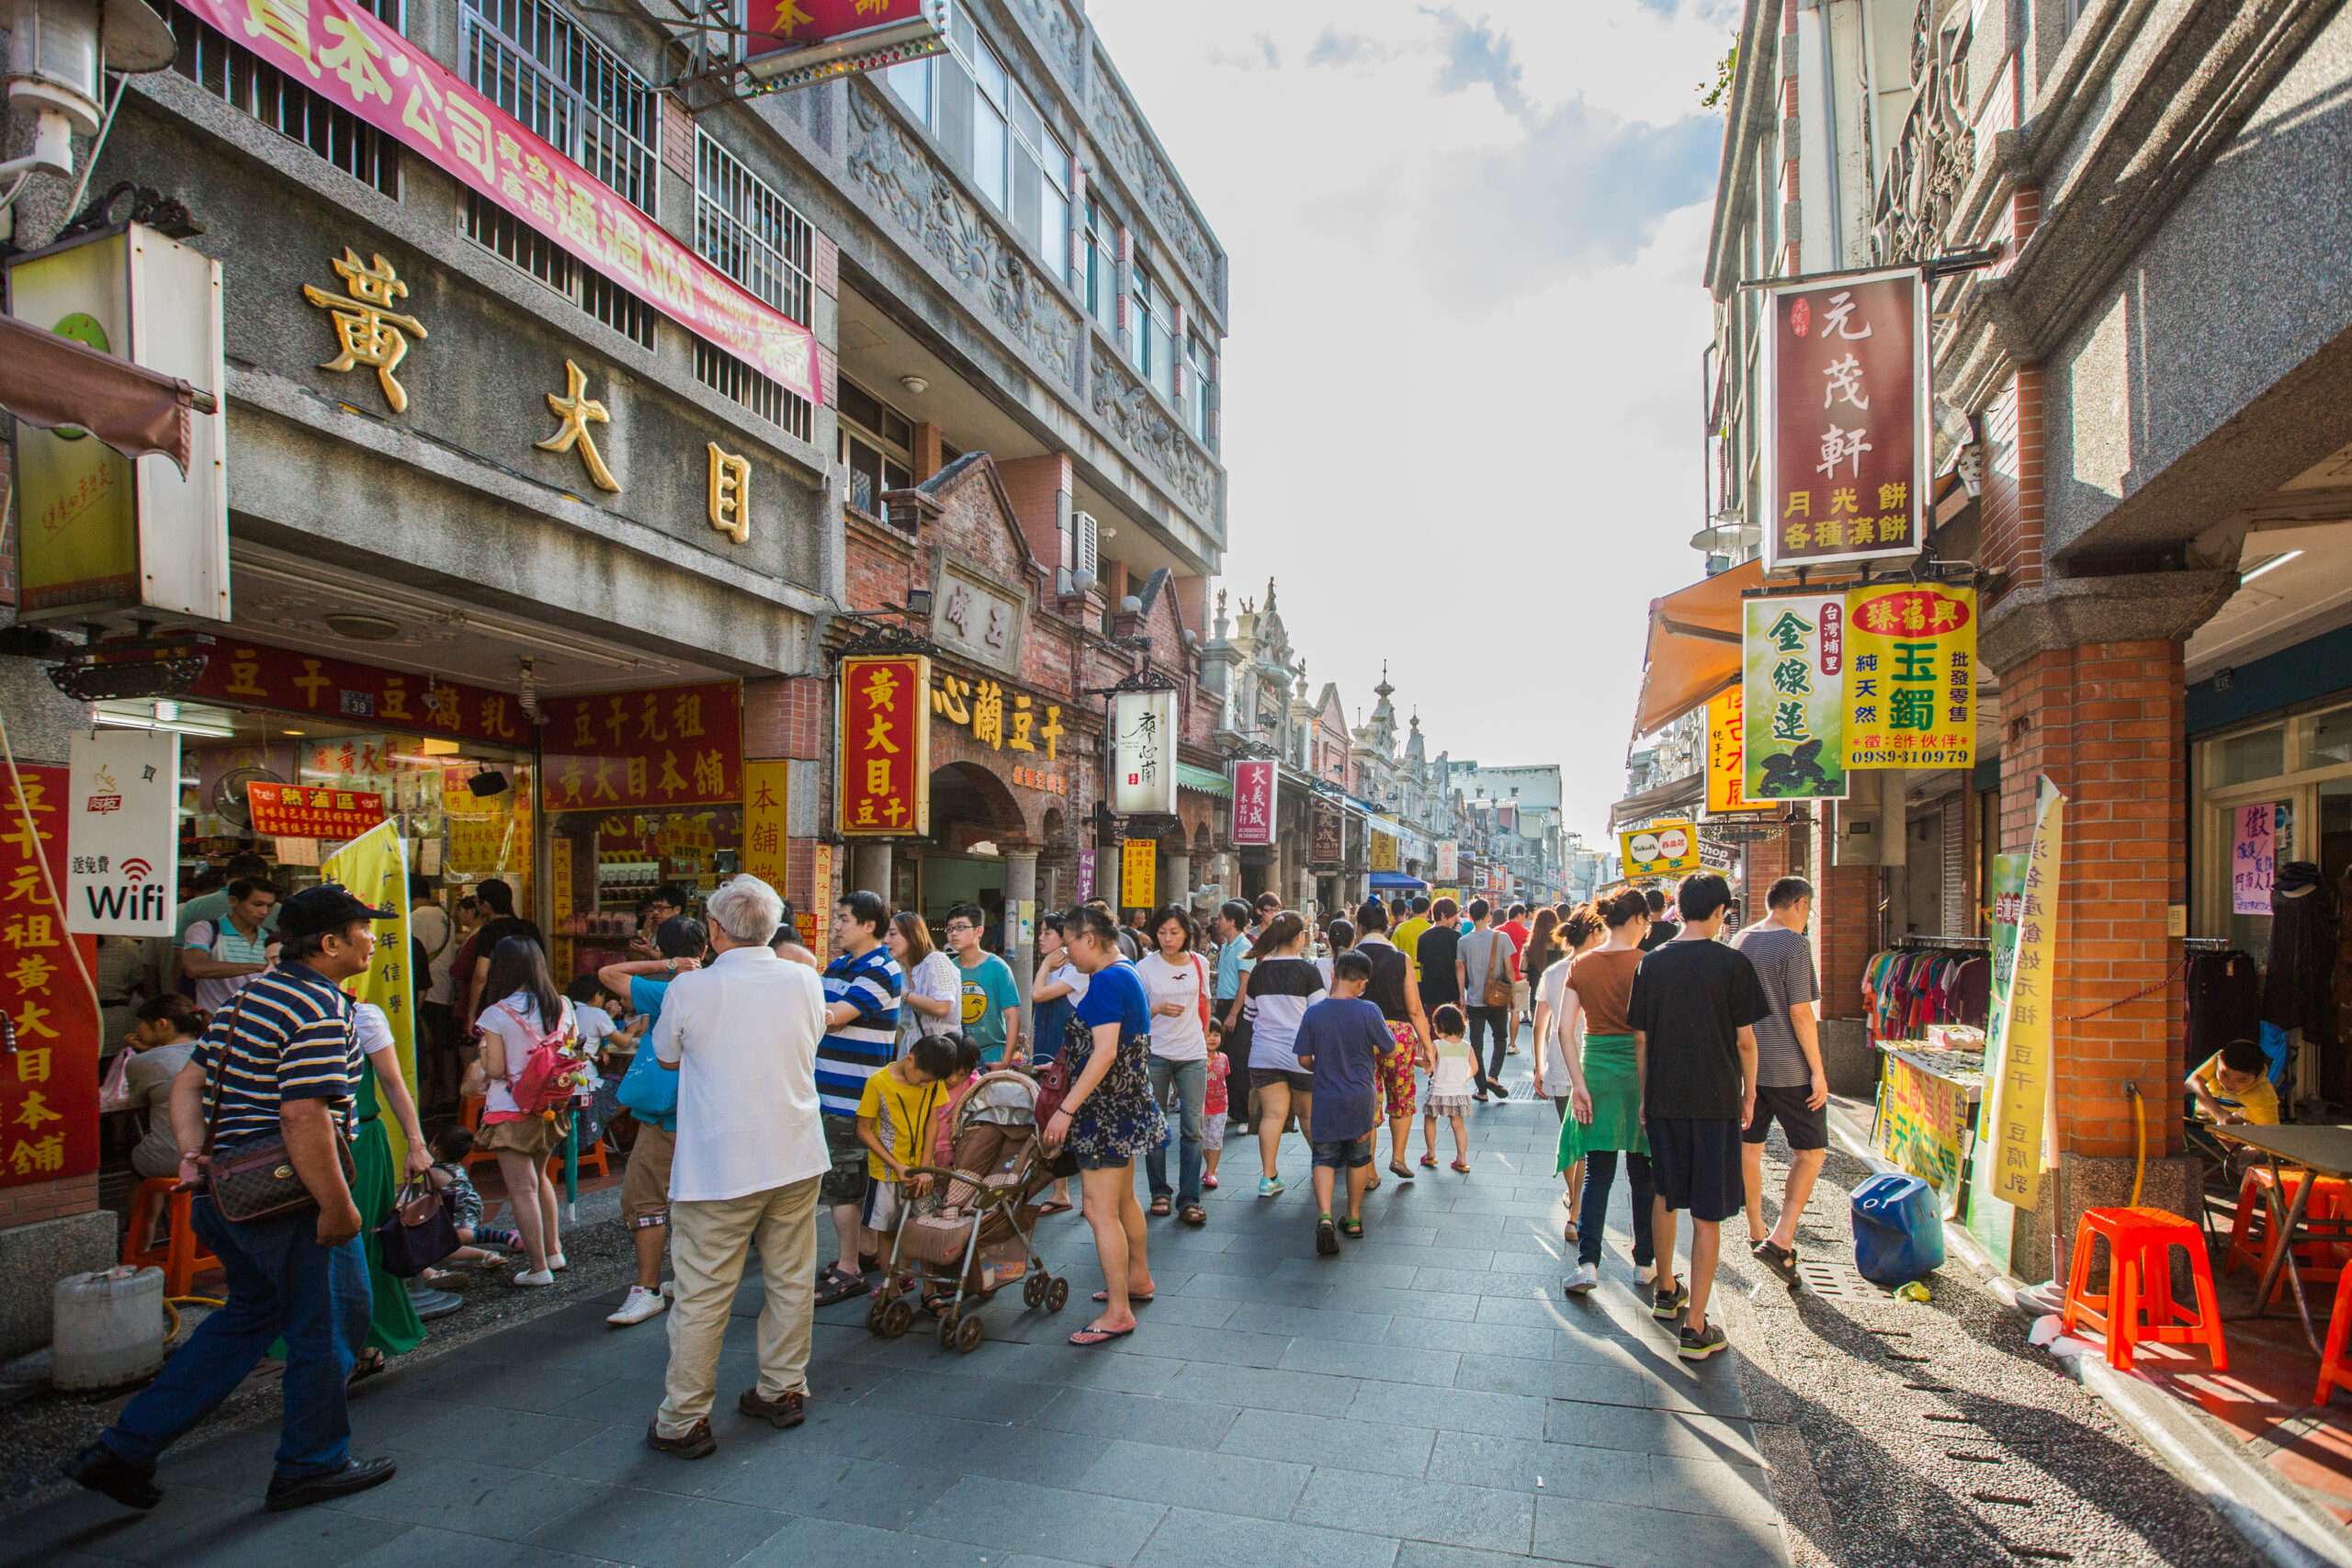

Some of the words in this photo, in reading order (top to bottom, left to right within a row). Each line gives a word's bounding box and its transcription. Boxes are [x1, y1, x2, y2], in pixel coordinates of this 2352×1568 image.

[303, 245, 755, 546] 黃大目
[1816, 290, 1872, 480] 元茂軒
[1784, 481, 1907, 518] 月光餅
[1784, 513, 1907, 550] 各種漢餅
[1823, 606, 1840, 671] 台灣埔里
[1866, 598, 1959, 631] 臻福興
[227, 649, 332, 708] 豆干
[379, 678, 515, 739] 豆腐乳
[1769, 612, 1813, 742] 金線蓮
[1854, 654, 1877, 724] 純天然
[1889, 643, 1938, 731] 玉鐲
[1949, 651, 1969, 723] 批發零售
[573, 693, 706, 749] 豆干元祖
[862, 667, 899, 797] 黃大目
[932, 675, 1065, 761] 心蘭豆干
[1852, 750, 1968, 764] 0989-310979
[856, 796, 907, 826] 豆干
[73, 856, 110, 874] 送免費
[86, 884, 164, 920] Wifi
